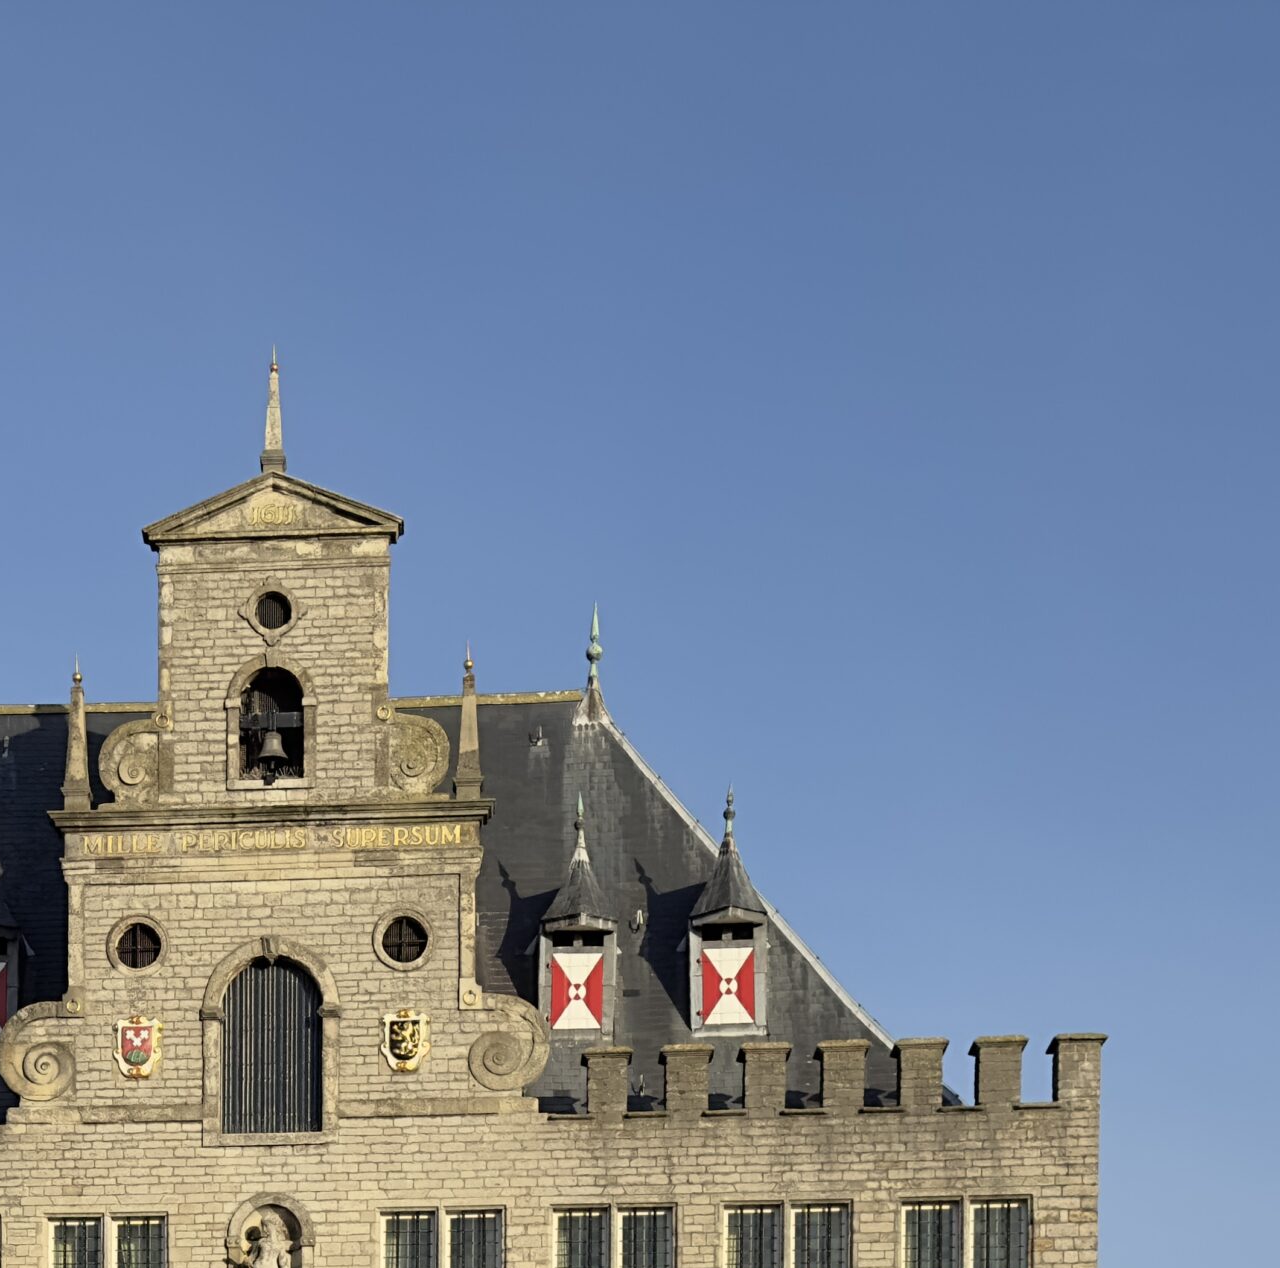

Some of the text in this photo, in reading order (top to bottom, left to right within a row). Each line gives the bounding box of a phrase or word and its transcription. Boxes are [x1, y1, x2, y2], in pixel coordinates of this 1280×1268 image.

[82, 824, 461, 855] MILLE PERICULIS SUPERSUM
